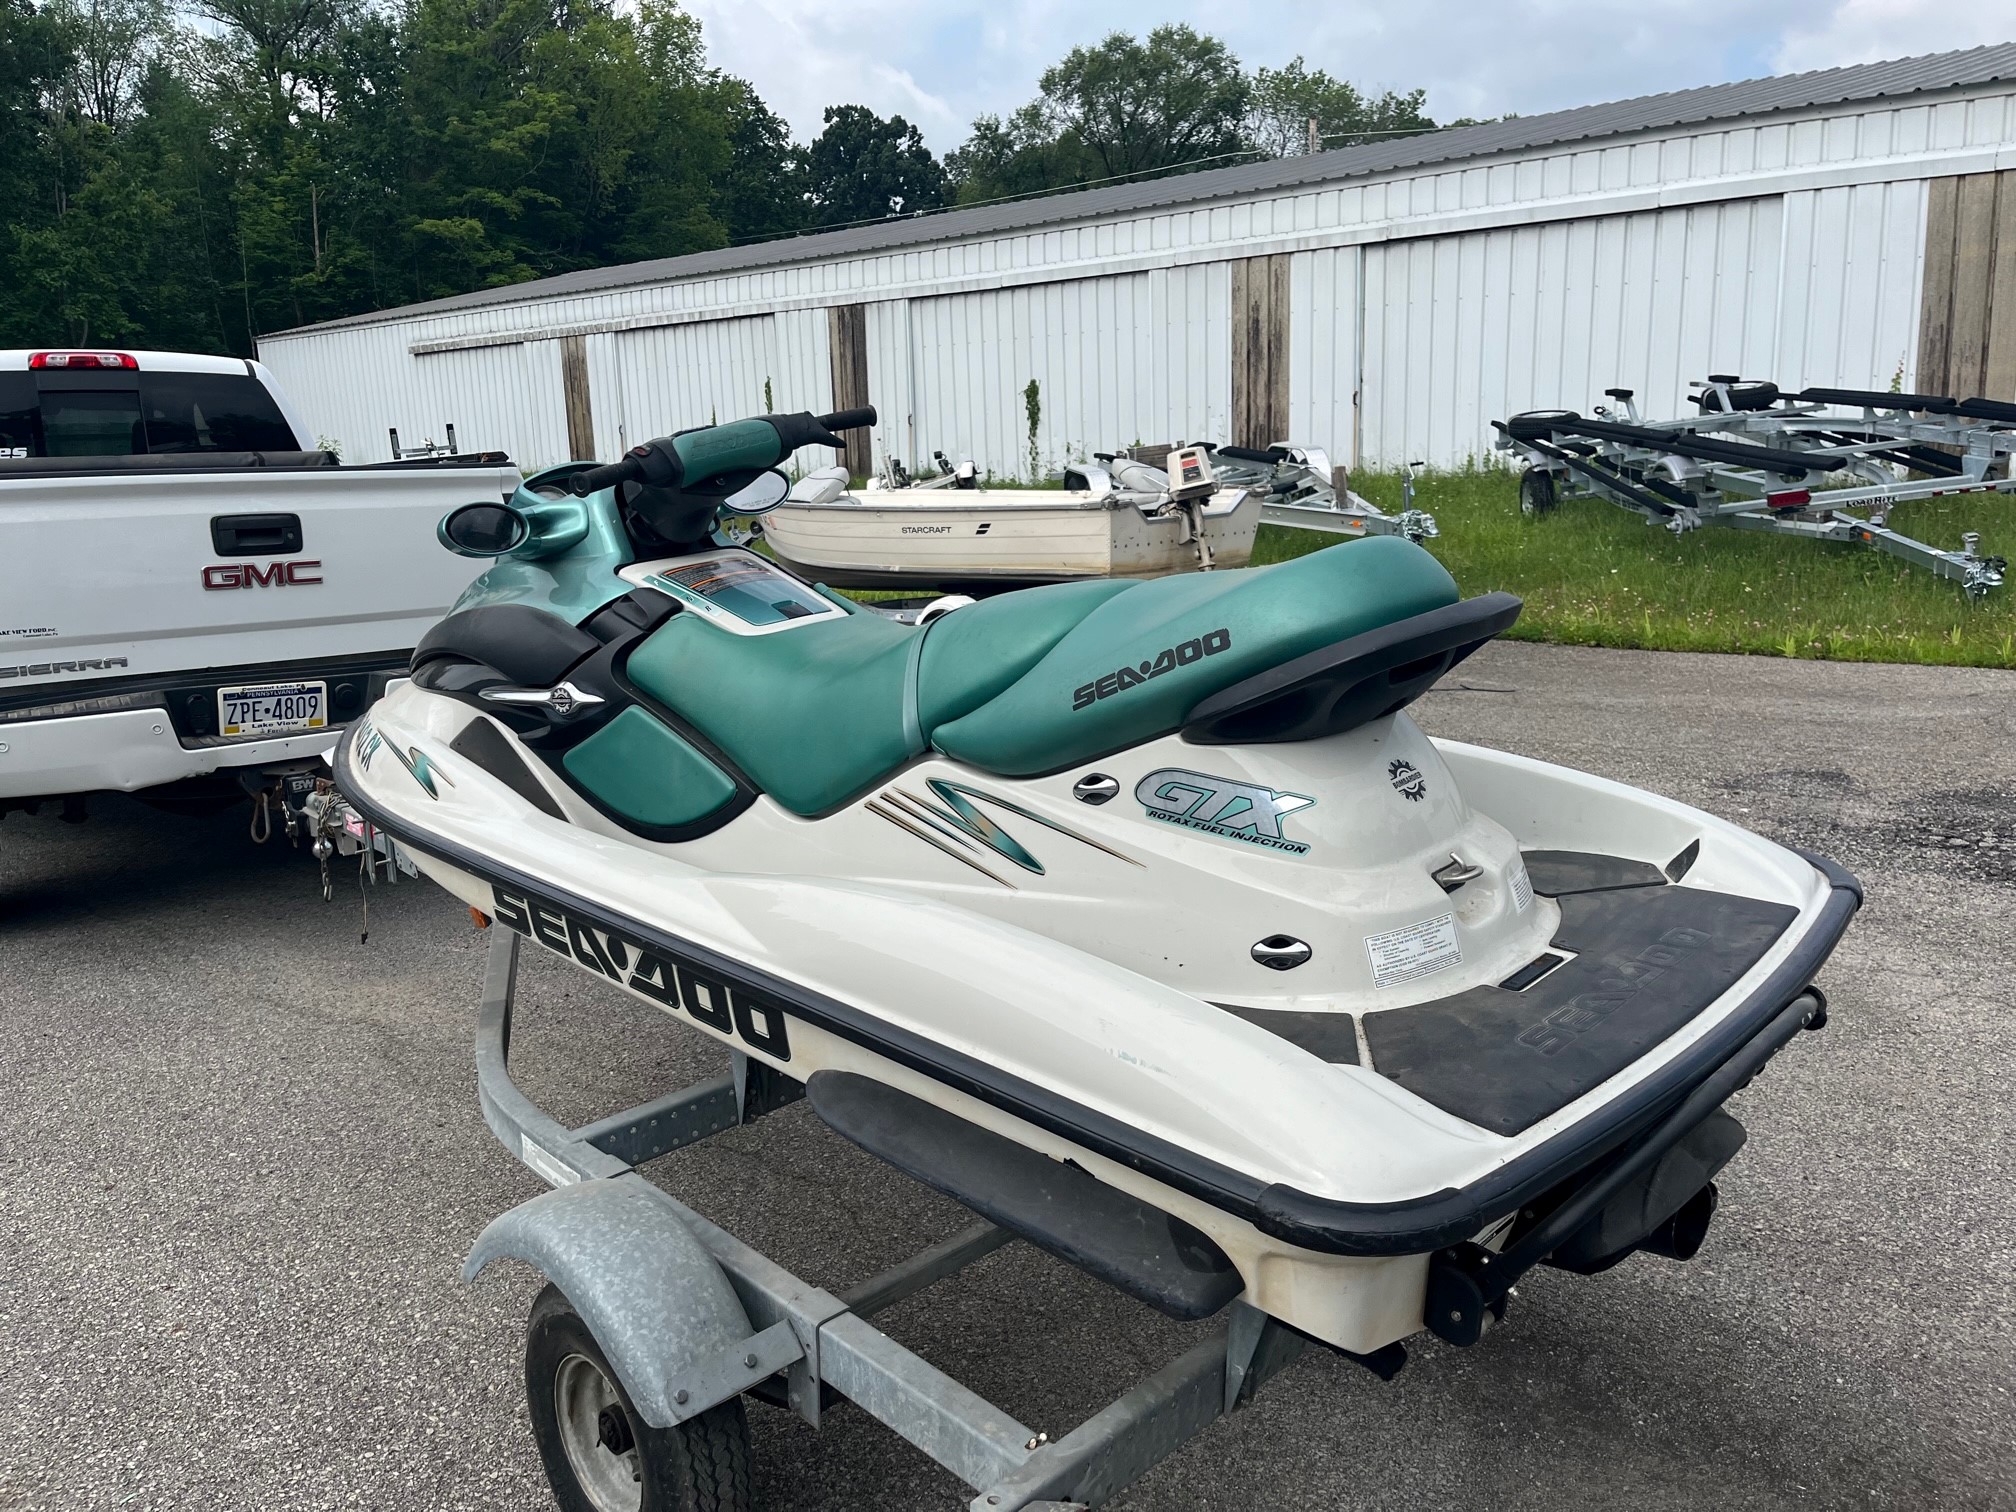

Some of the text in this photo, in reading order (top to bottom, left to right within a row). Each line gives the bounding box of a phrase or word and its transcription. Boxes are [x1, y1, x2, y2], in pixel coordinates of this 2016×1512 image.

[901, 526, 952, 534] STARCRAFT
[201, 559, 323, 591] GMC
[0, 656, 128, 679] SIERRA
[246, 689, 299, 698] PENNSYLVANIA
[1135, 768, 1315, 839] GTX
[1148, 810, 1308, 854] ROTAX FUEL INJECTION
